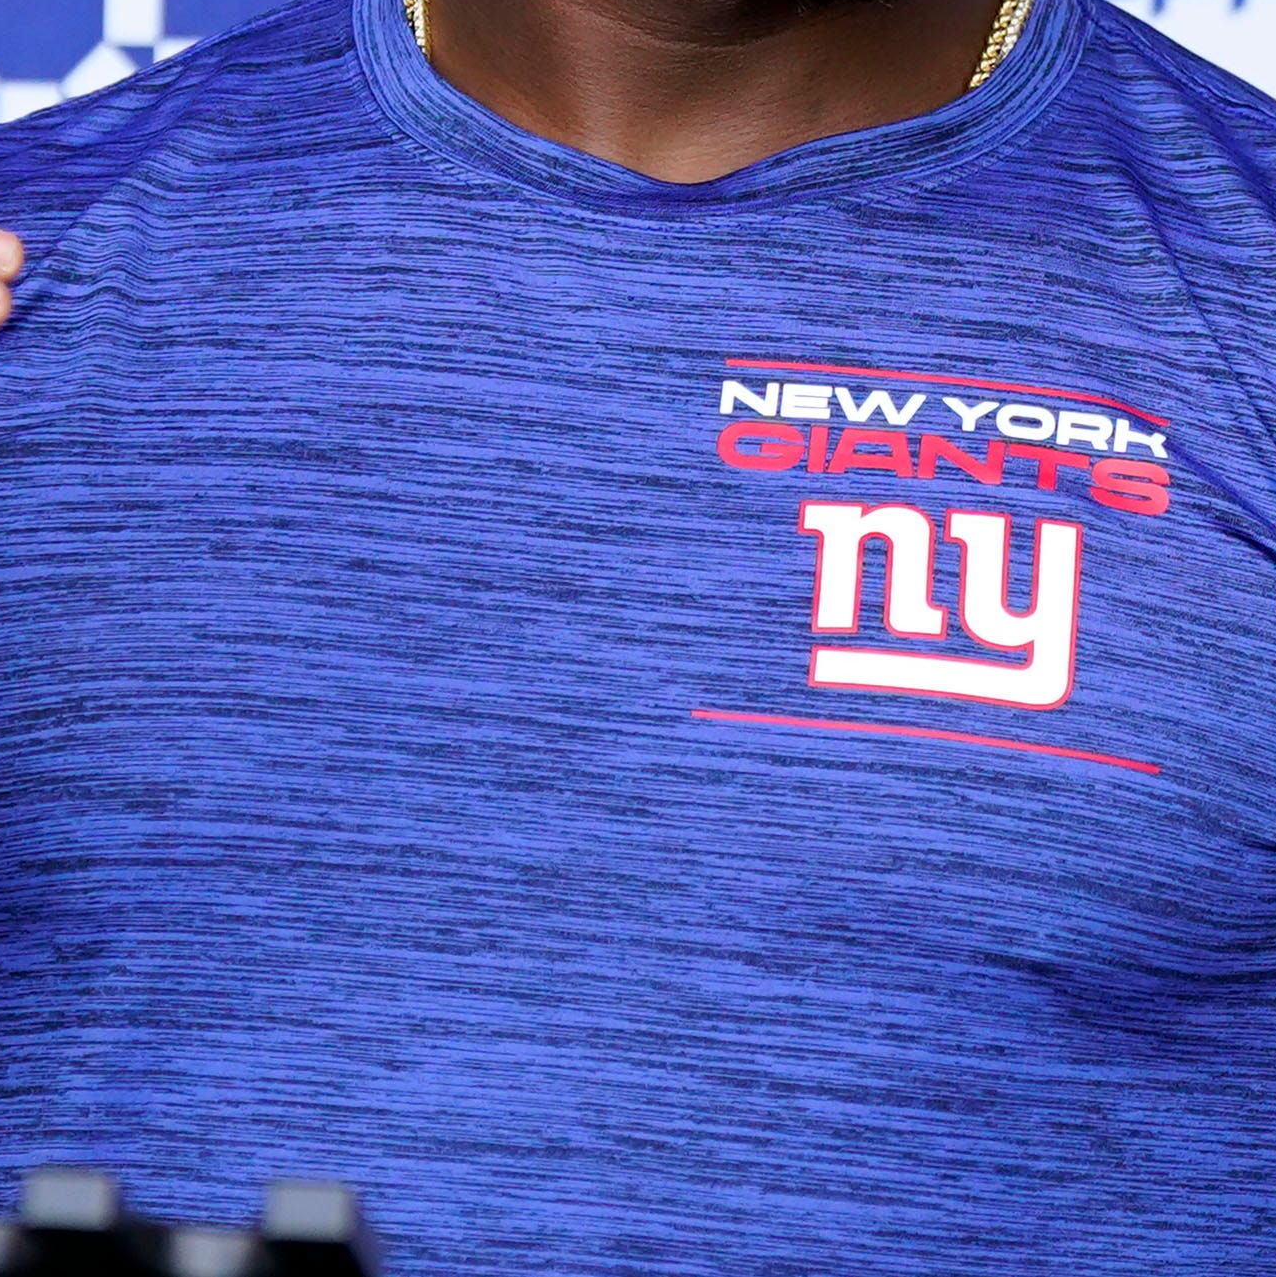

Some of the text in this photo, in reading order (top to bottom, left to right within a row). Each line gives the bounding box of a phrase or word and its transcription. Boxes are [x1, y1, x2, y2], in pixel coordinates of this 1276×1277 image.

[719, 381, 1169, 459] NEW YORK
[717, 421, 1171, 516] GIANTS
